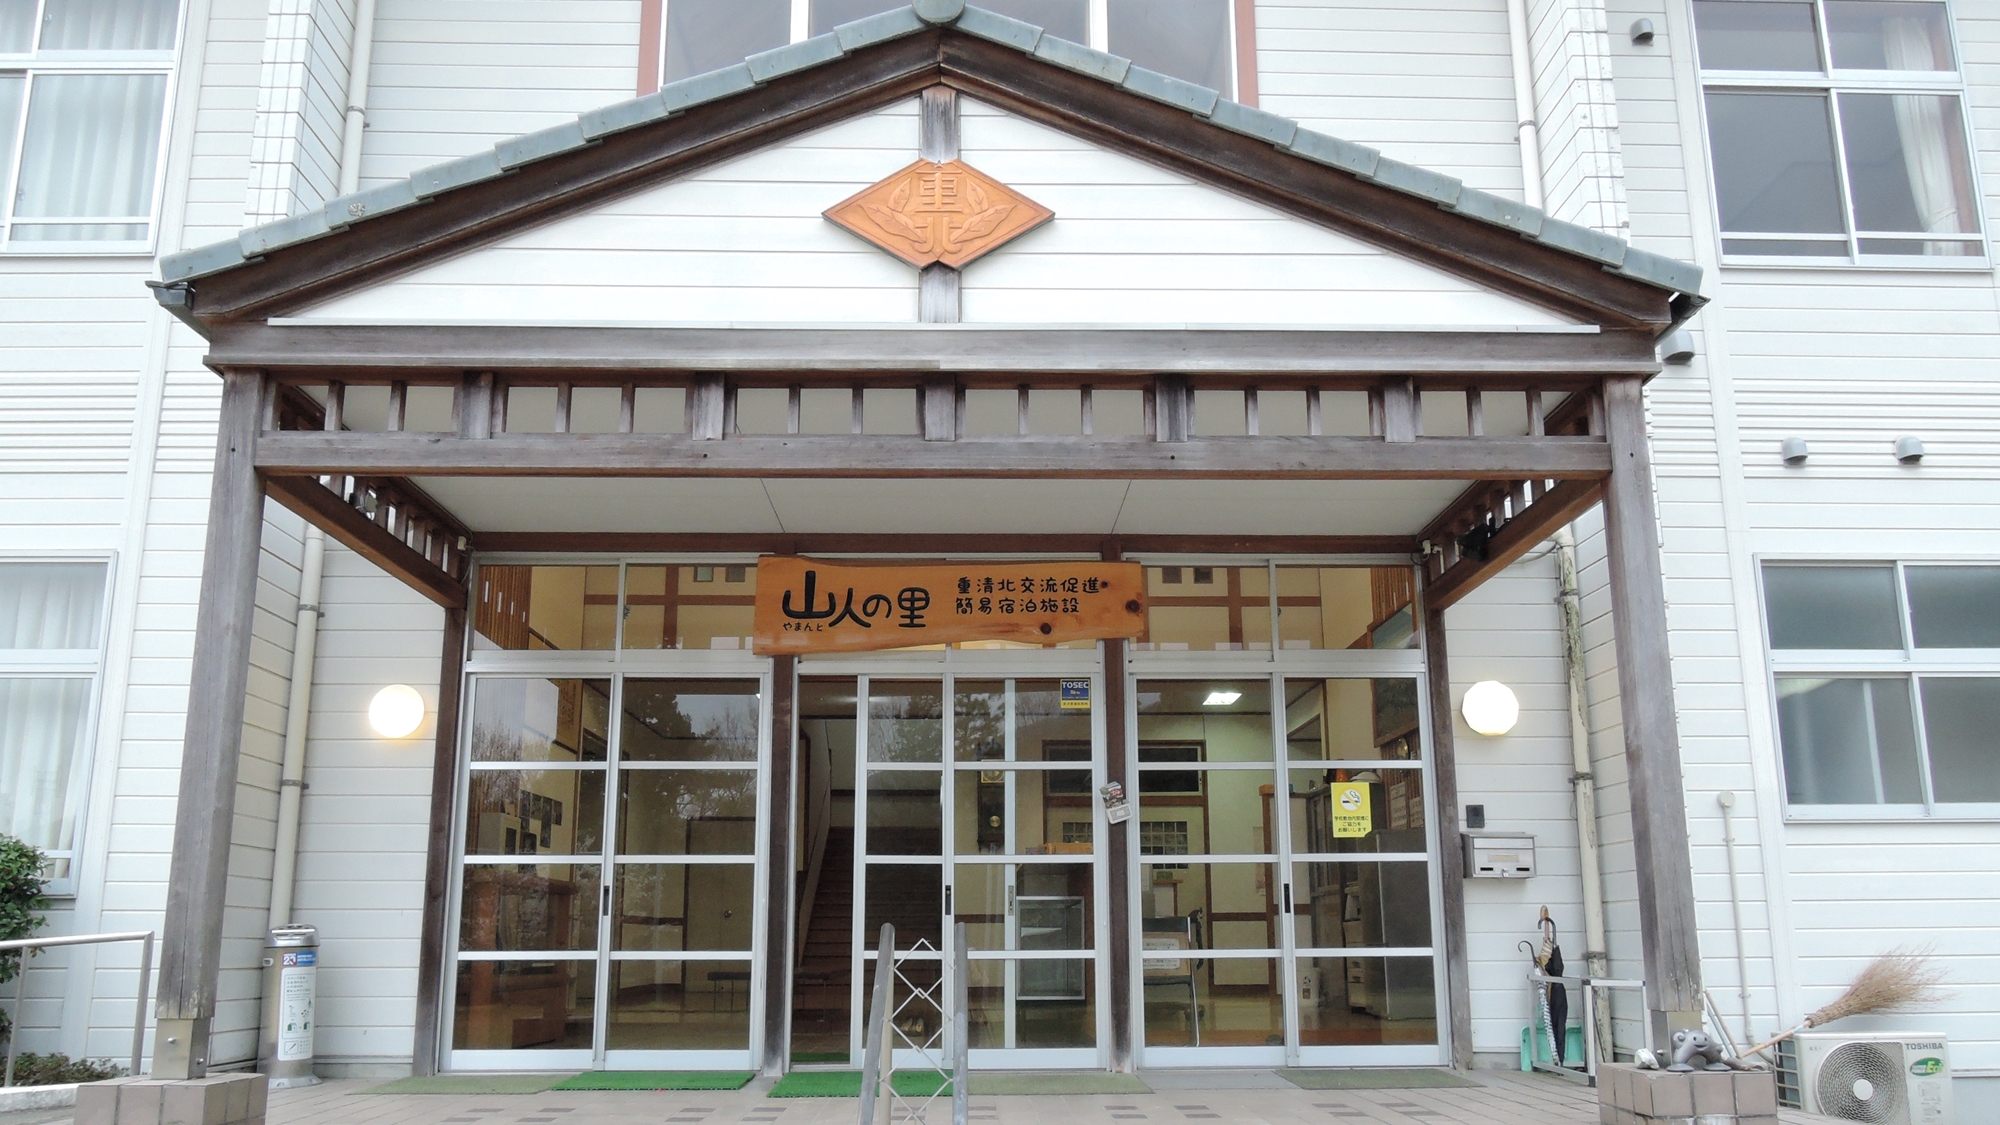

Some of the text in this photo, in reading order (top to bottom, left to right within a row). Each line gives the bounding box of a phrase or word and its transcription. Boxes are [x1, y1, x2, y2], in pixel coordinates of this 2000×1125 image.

[957, 576, 1100, 594] 重清北交流促進
[781, 570, 931, 628] 山人の里
[955, 597, 1080, 615] 簡易宿泊施設
[783, 622, 823, 632] やまんと
[1062, 681, 1089, 689] TOSEC
